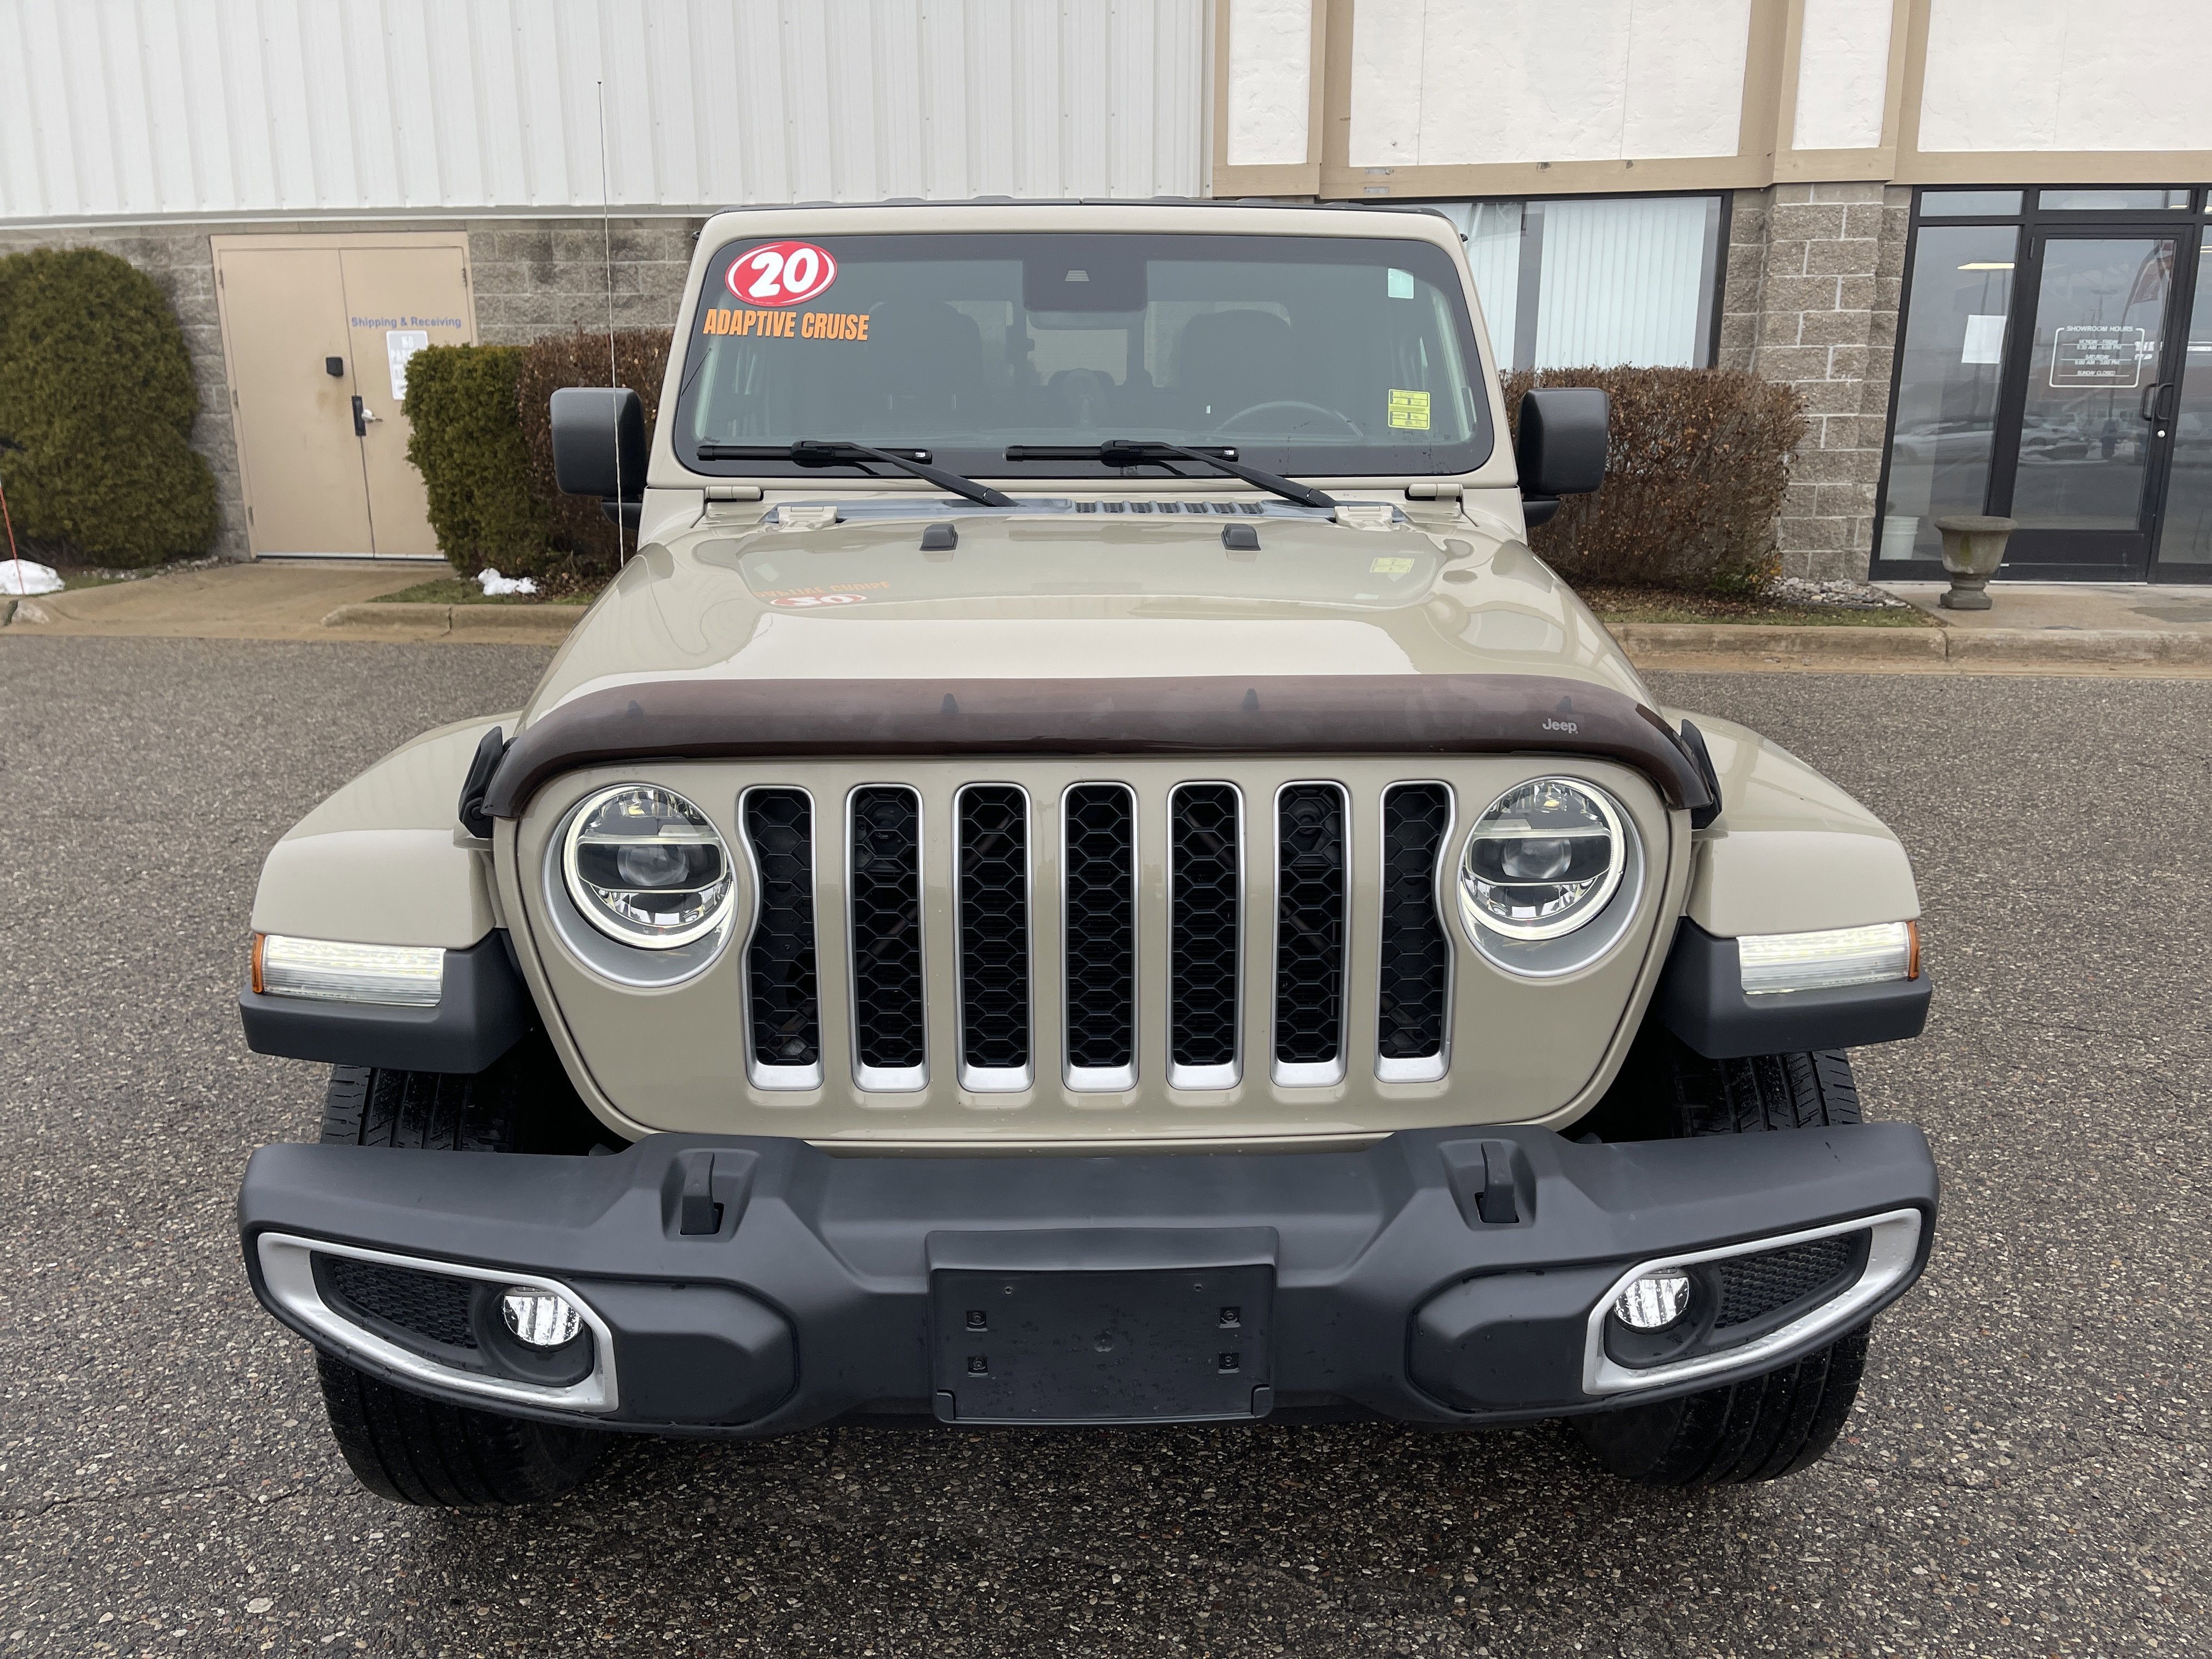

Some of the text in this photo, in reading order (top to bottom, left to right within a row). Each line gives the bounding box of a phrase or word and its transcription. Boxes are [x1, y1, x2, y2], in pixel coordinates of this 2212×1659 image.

[748, 247, 819, 298] 20
[352, 316, 461, 328] Shipping & Receiving
[703, 308, 870, 341] ADAPTIVE CRUISE
[1542, 718, 1578, 734] Jeep
